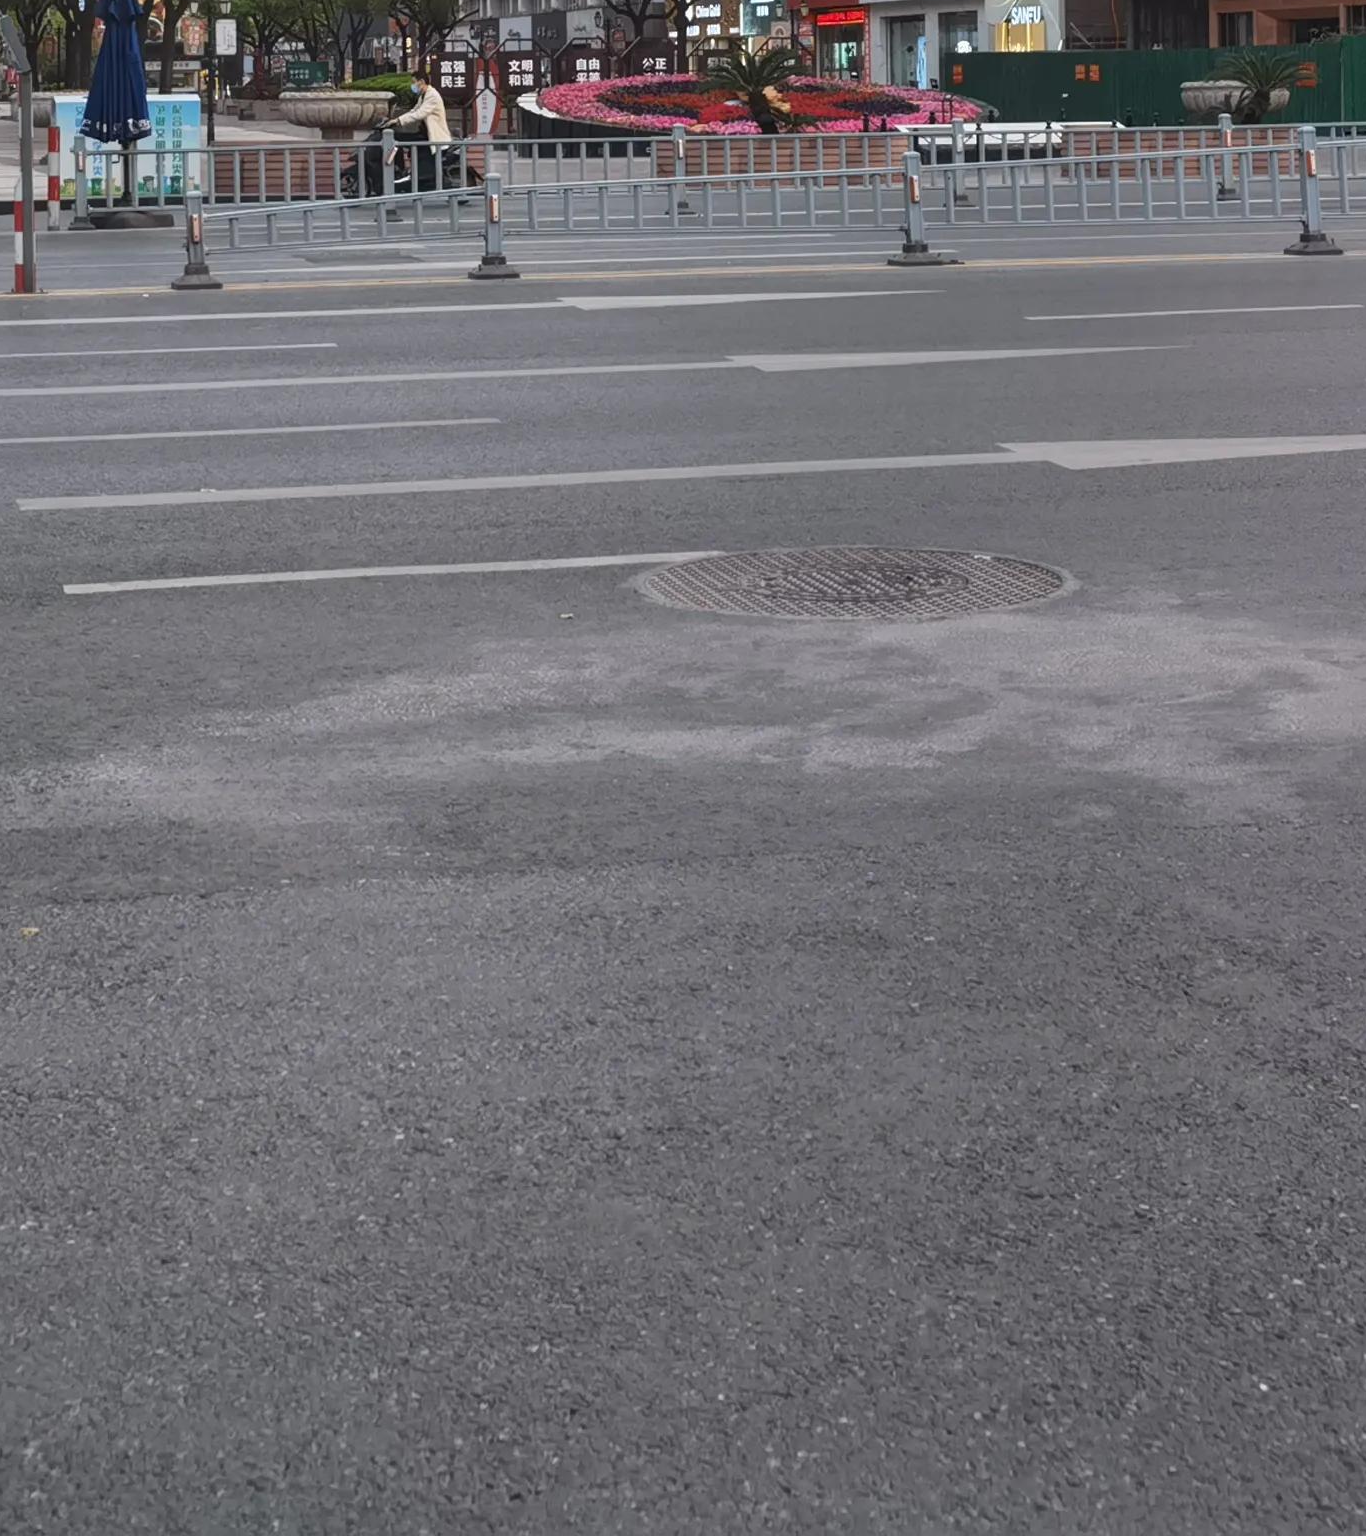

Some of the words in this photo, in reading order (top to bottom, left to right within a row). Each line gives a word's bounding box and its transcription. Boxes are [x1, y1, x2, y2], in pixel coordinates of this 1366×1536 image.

[1010, 7, 1041, 24] SANFU
[440, 60, 466, 74] 富强
[508, 59, 533, 73] 文明
[576, 58, 600, 72] 自由
[642, 57, 667, 70] 公正
[440, 75, 466, 88] 民主
[508, 73, 534, 87] 和谐
